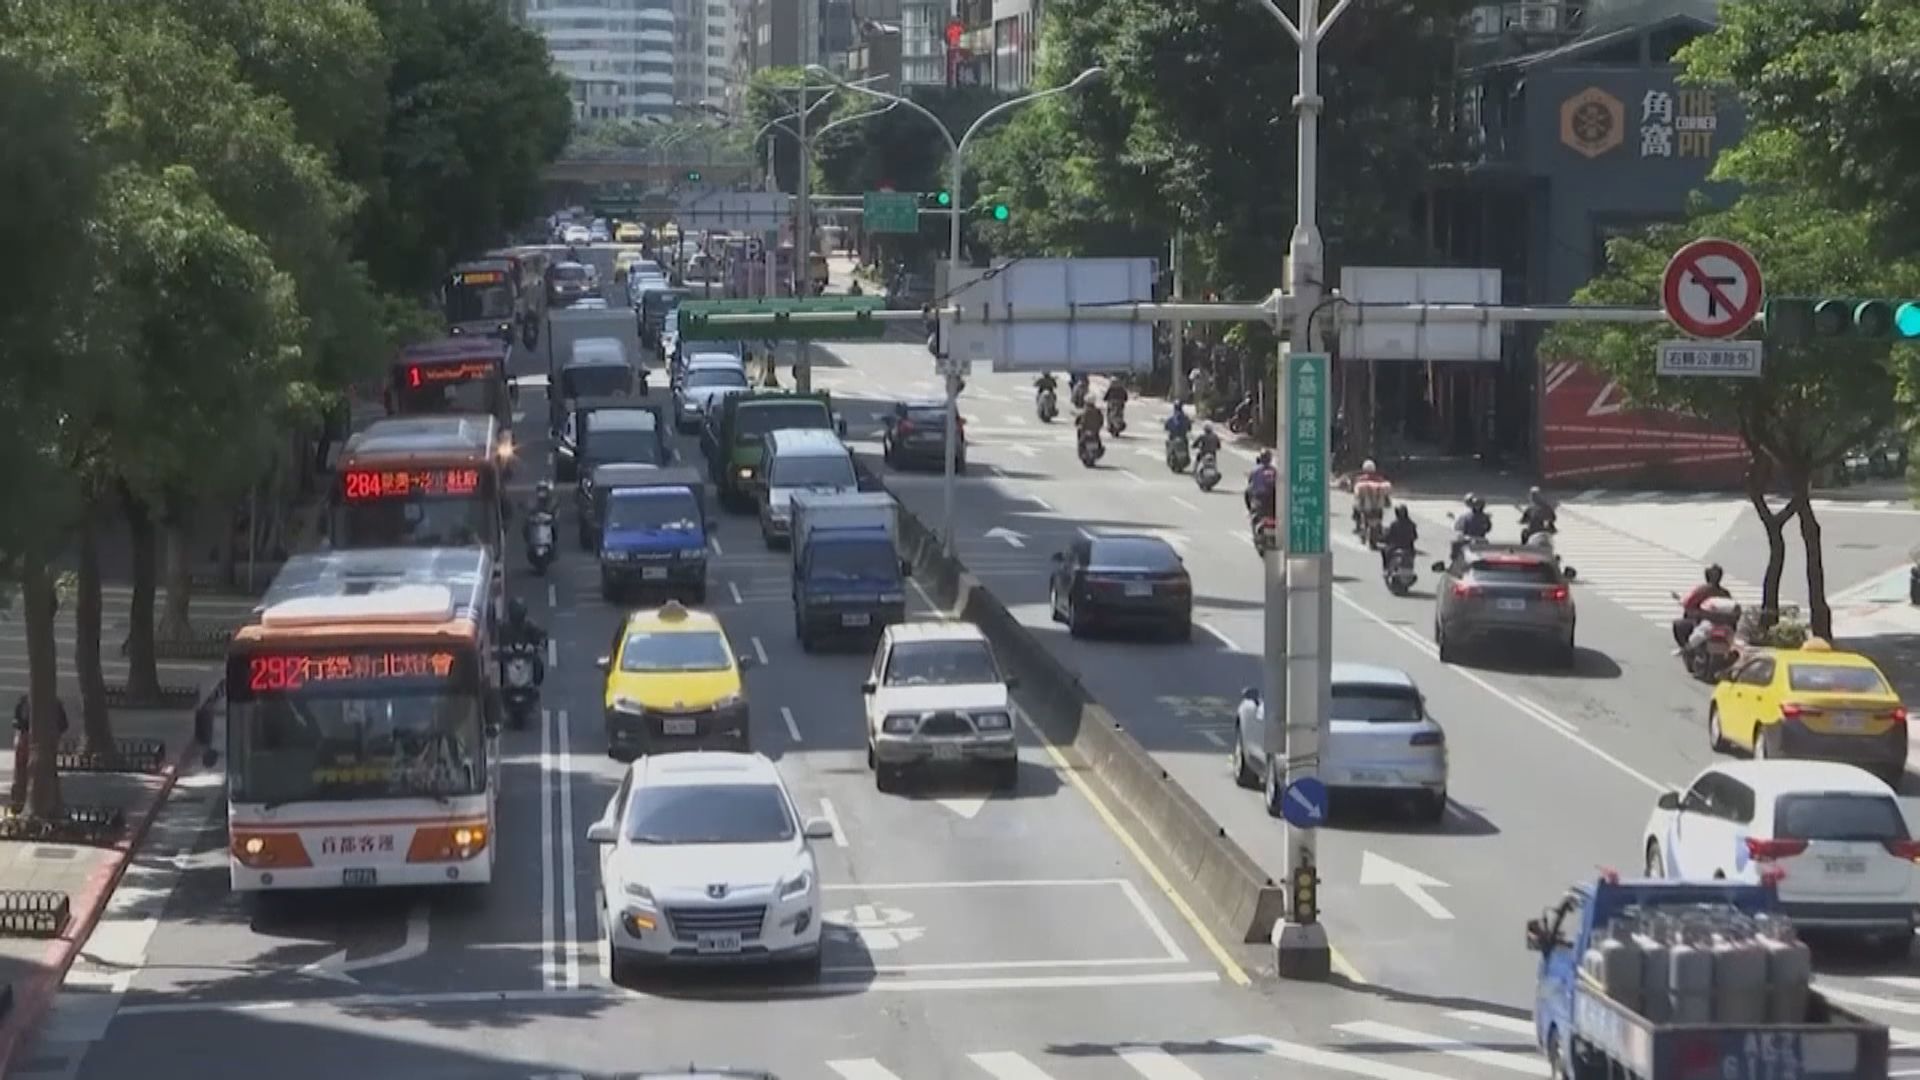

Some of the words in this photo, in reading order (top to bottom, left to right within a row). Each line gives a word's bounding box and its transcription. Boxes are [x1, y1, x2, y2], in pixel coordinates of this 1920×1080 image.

[1679, 90, 1716, 115] THE
[1641, 90, 1673, 157] 角窩
[1679, 132, 1713, 157] PIT
[1669, 351, 1749, 368] 右轉公車除外
[346, 472, 381, 498] 284
[250, 656, 301, 690] 292
